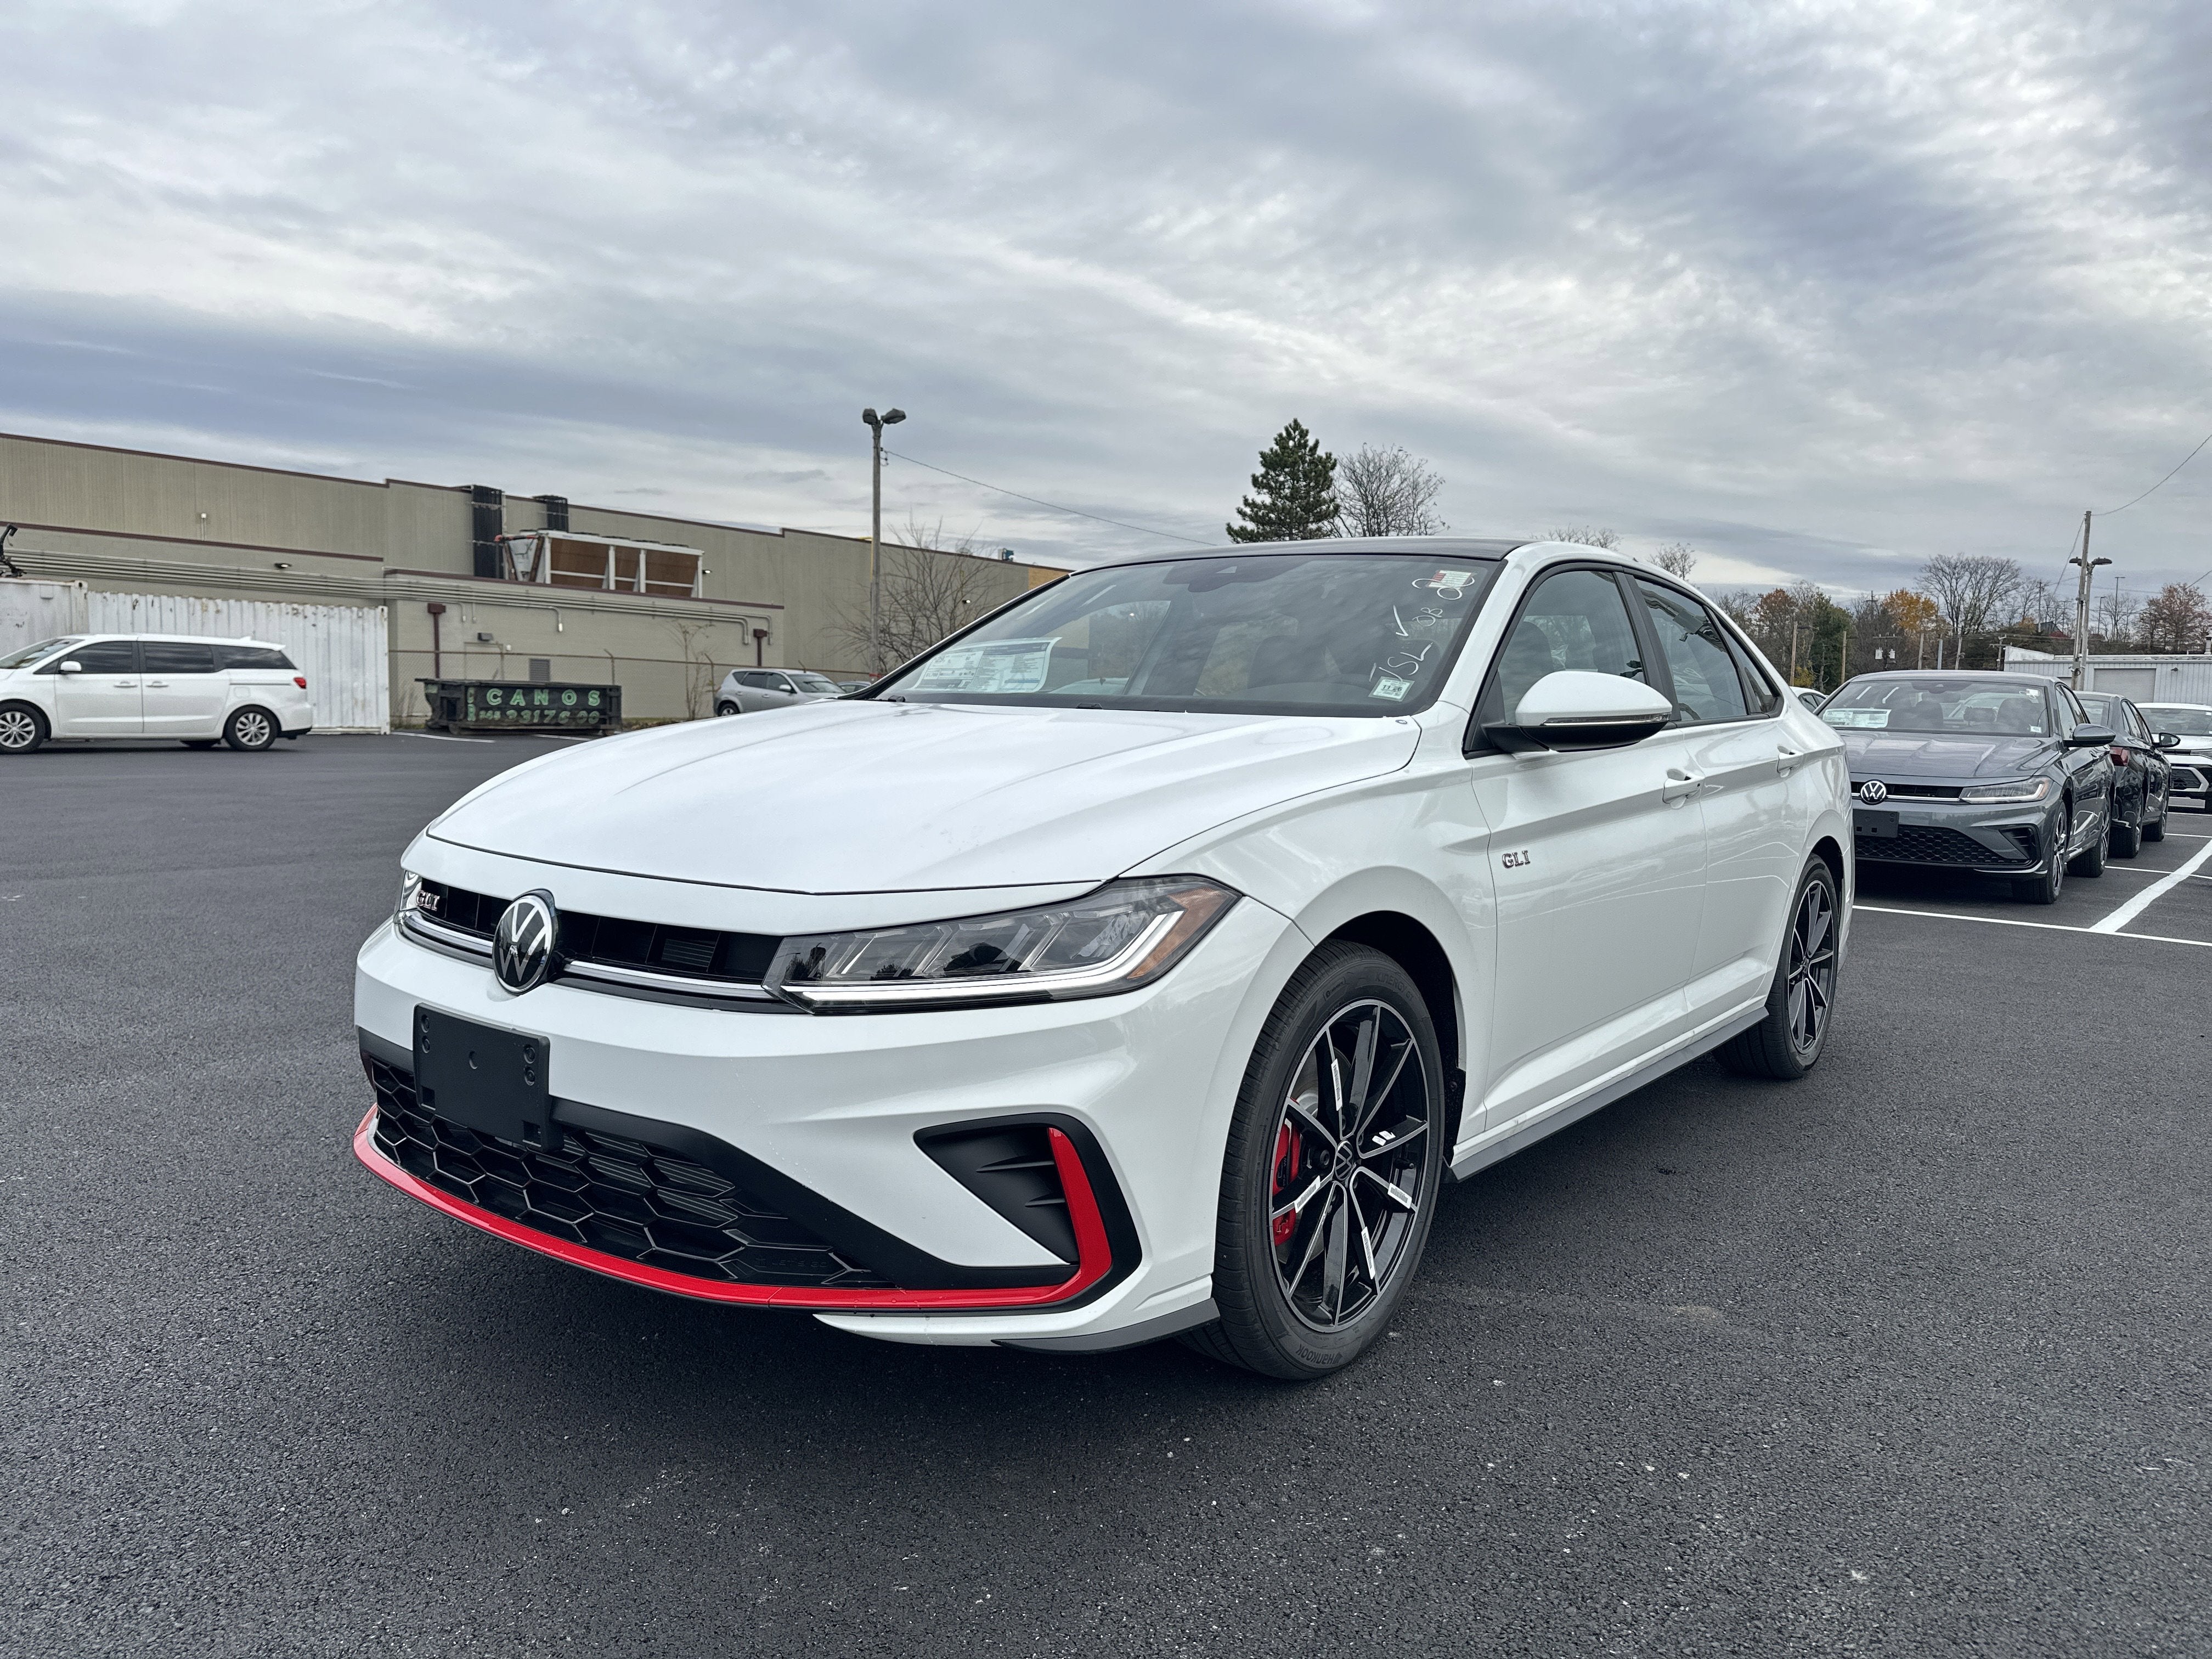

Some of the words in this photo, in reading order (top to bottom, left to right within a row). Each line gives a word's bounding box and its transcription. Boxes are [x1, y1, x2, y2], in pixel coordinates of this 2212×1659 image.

[486, 688, 601, 707] CANOS
[1502, 850, 1531, 868] GLI
[495, 896, 551, 988] VW
